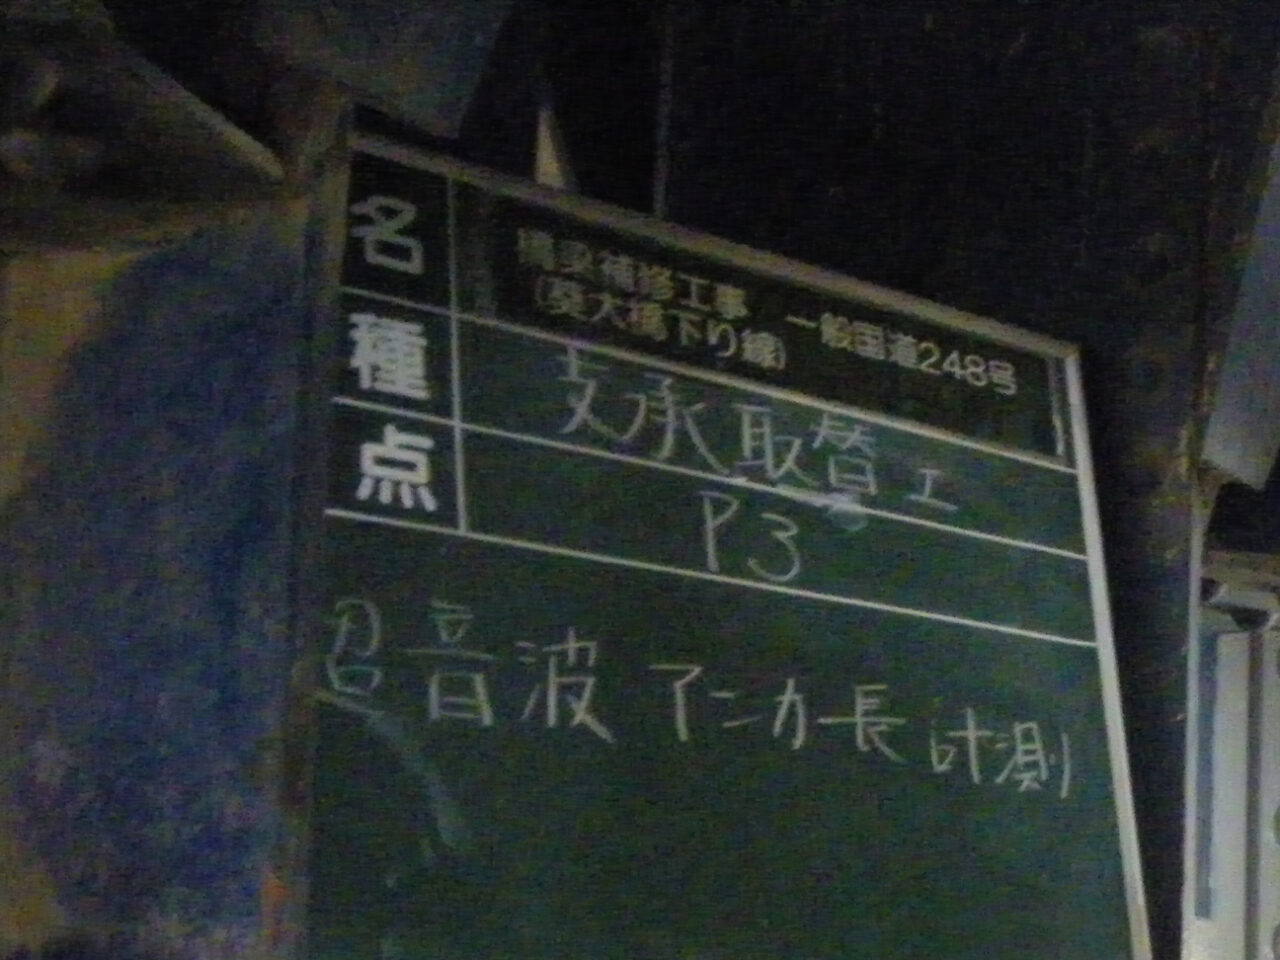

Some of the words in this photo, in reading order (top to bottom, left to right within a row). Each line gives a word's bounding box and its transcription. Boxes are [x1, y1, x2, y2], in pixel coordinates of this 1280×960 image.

[350, 312, 432, 400] 種
[356, 422, 437, 512] 点
[702, 490, 799, 582] P3
